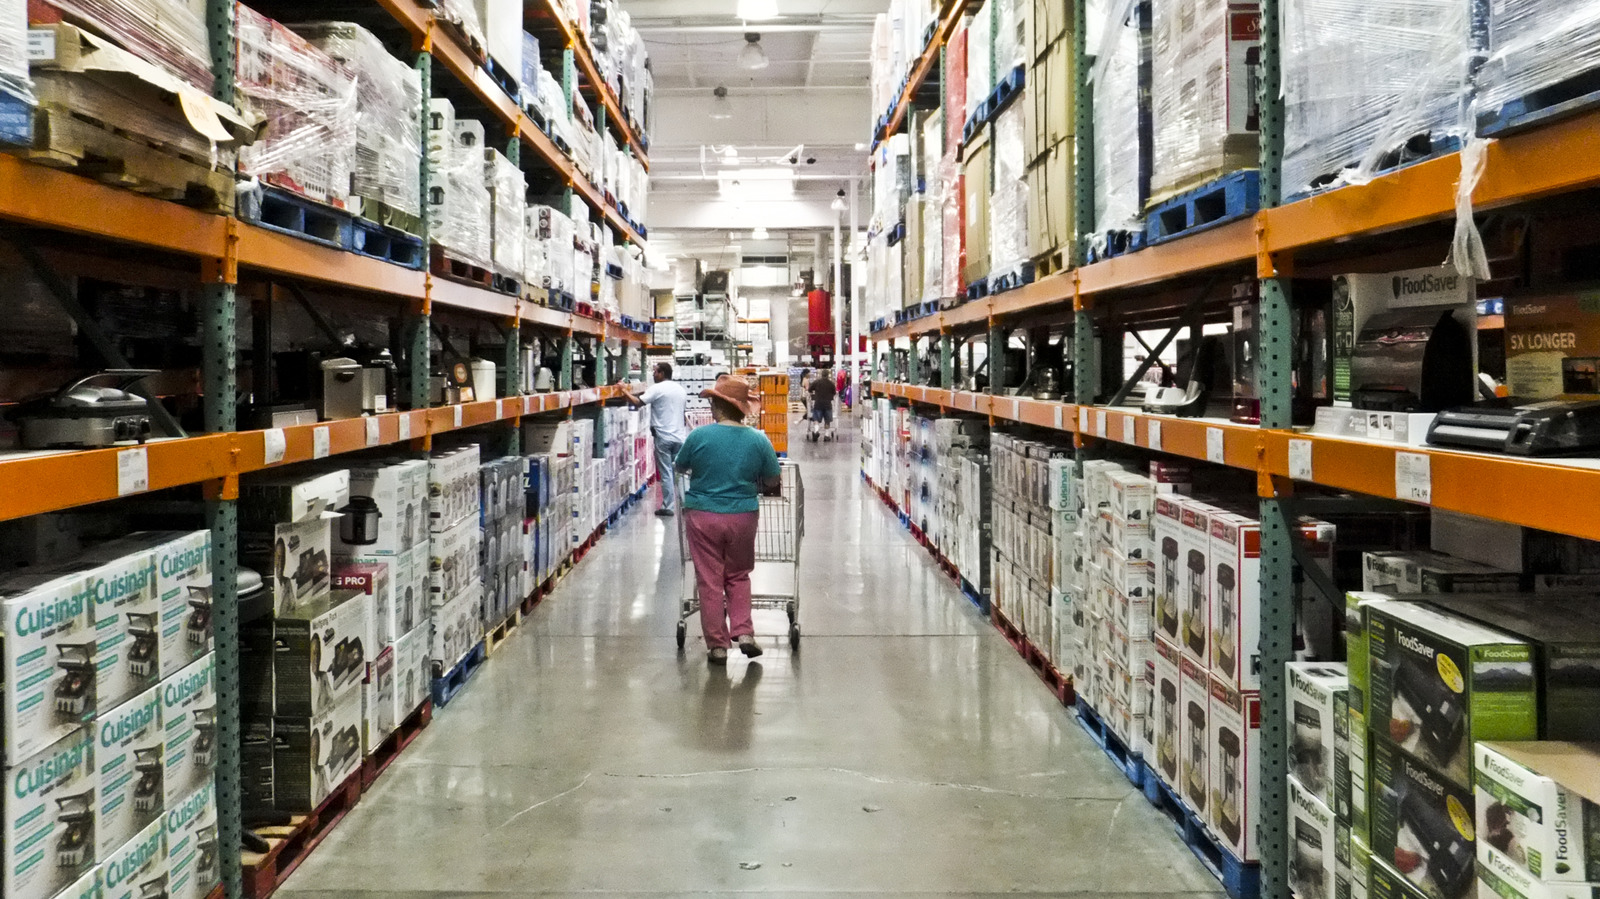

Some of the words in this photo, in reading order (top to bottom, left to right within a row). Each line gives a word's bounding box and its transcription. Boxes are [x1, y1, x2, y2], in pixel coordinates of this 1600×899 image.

[1402, 274, 1458, 295] FoodSaver
[1512, 303, 1546, 315] FoodSaver
[1528, 332, 1576, 350] LONGER
[1060, 465, 1068, 508] Cuisinart
[161, 543, 212, 578] Cuisinart
[1372, 559, 1402, 578] FoodSaver
[95, 563, 157, 605] Cuisinart
[345, 576, 366, 586] PRO
[16, 587, 97, 637] Cuisinart
[1397, 630, 1435, 659] FoodSaver
[1484, 650, 1529, 658] FoodSaver
[164, 660, 216, 708] Cuisinart
[1295, 673, 1327, 706] FoodSaver
[101, 695, 162, 748] Cuisinart
[14, 735, 95, 799] Cuisinart
[1405, 761, 1445, 796] FoodSaver
[1489, 759, 1525, 788] FoodSaver
[1296, 791, 1329, 828] FoodSaver
[1555, 792, 1568, 861] FoodSaver
[106, 820, 168, 889] Cuisinart
[1494, 855, 1532, 889] FoodSaver
